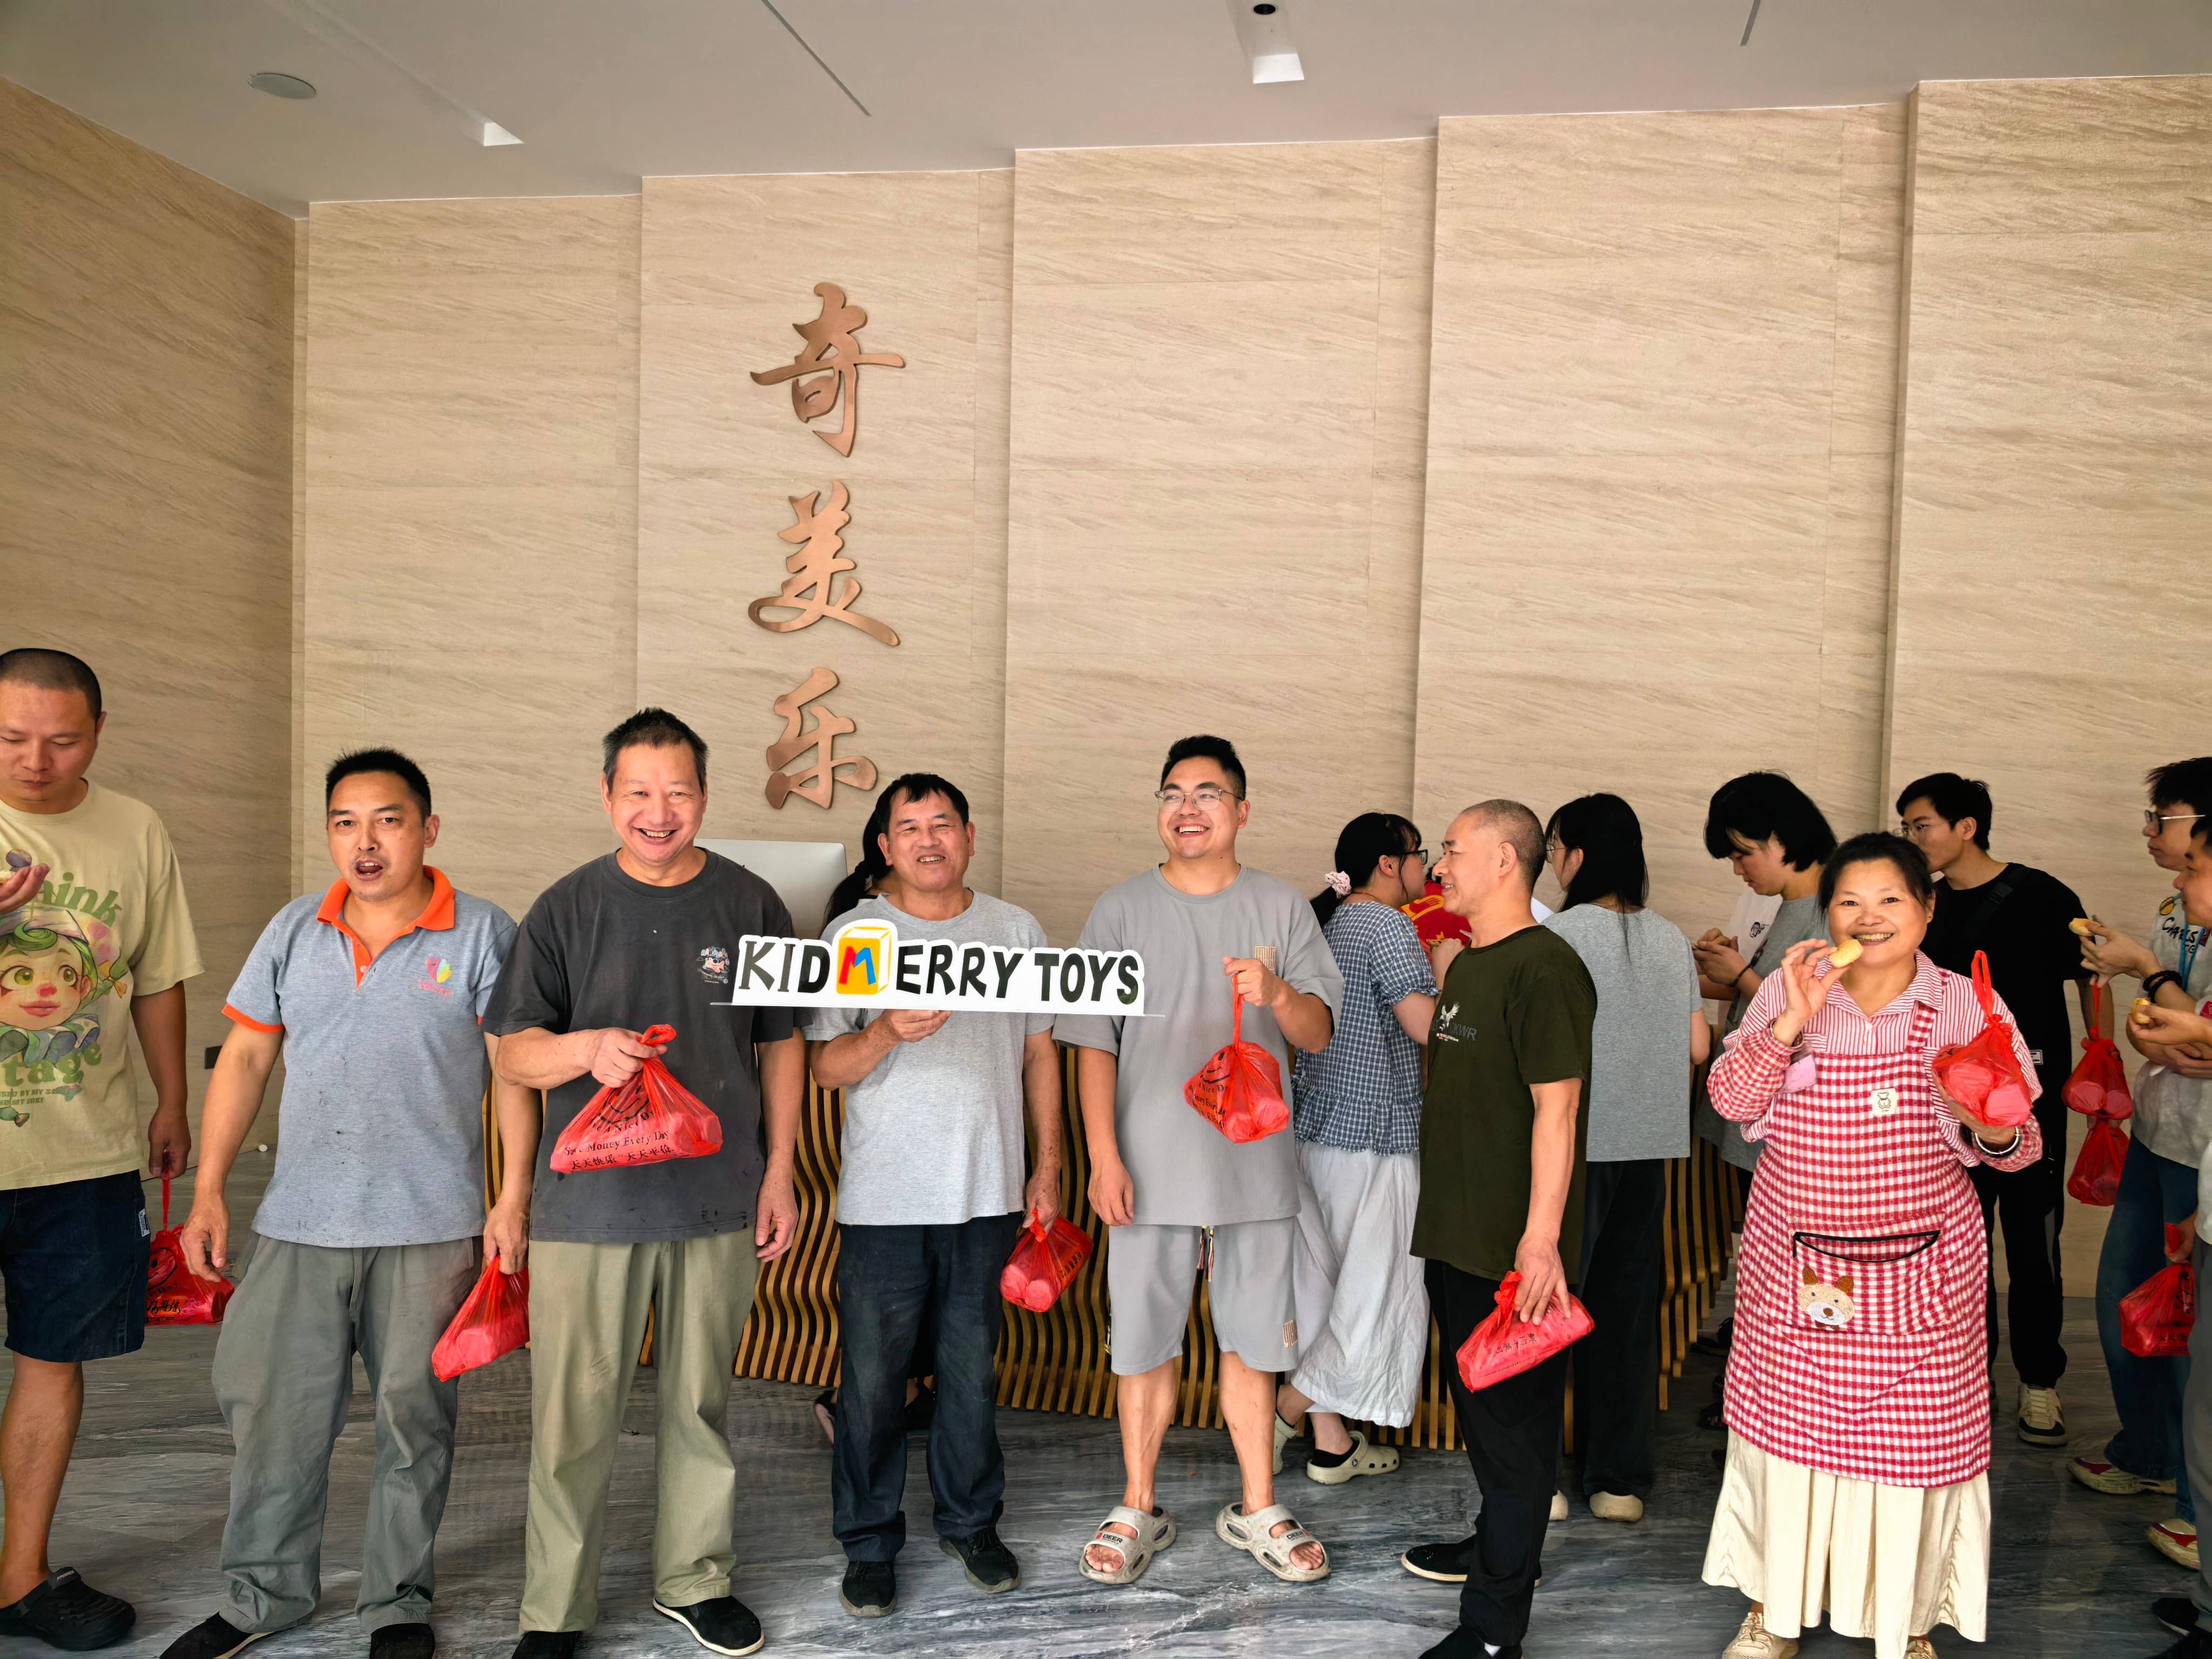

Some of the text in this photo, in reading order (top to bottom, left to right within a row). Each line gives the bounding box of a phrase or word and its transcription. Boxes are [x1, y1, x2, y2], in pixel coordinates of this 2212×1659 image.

[748, 281, 906, 810] 奇美乐
[1034, 953, 1139, 1004] TOYS
[588, 1141, 620, 1152] Money
[623, 1136, 651, 1146] Every
[654, 1130, 669, 1141] Day
[1102, 1534, 1123, 1543] DEER
